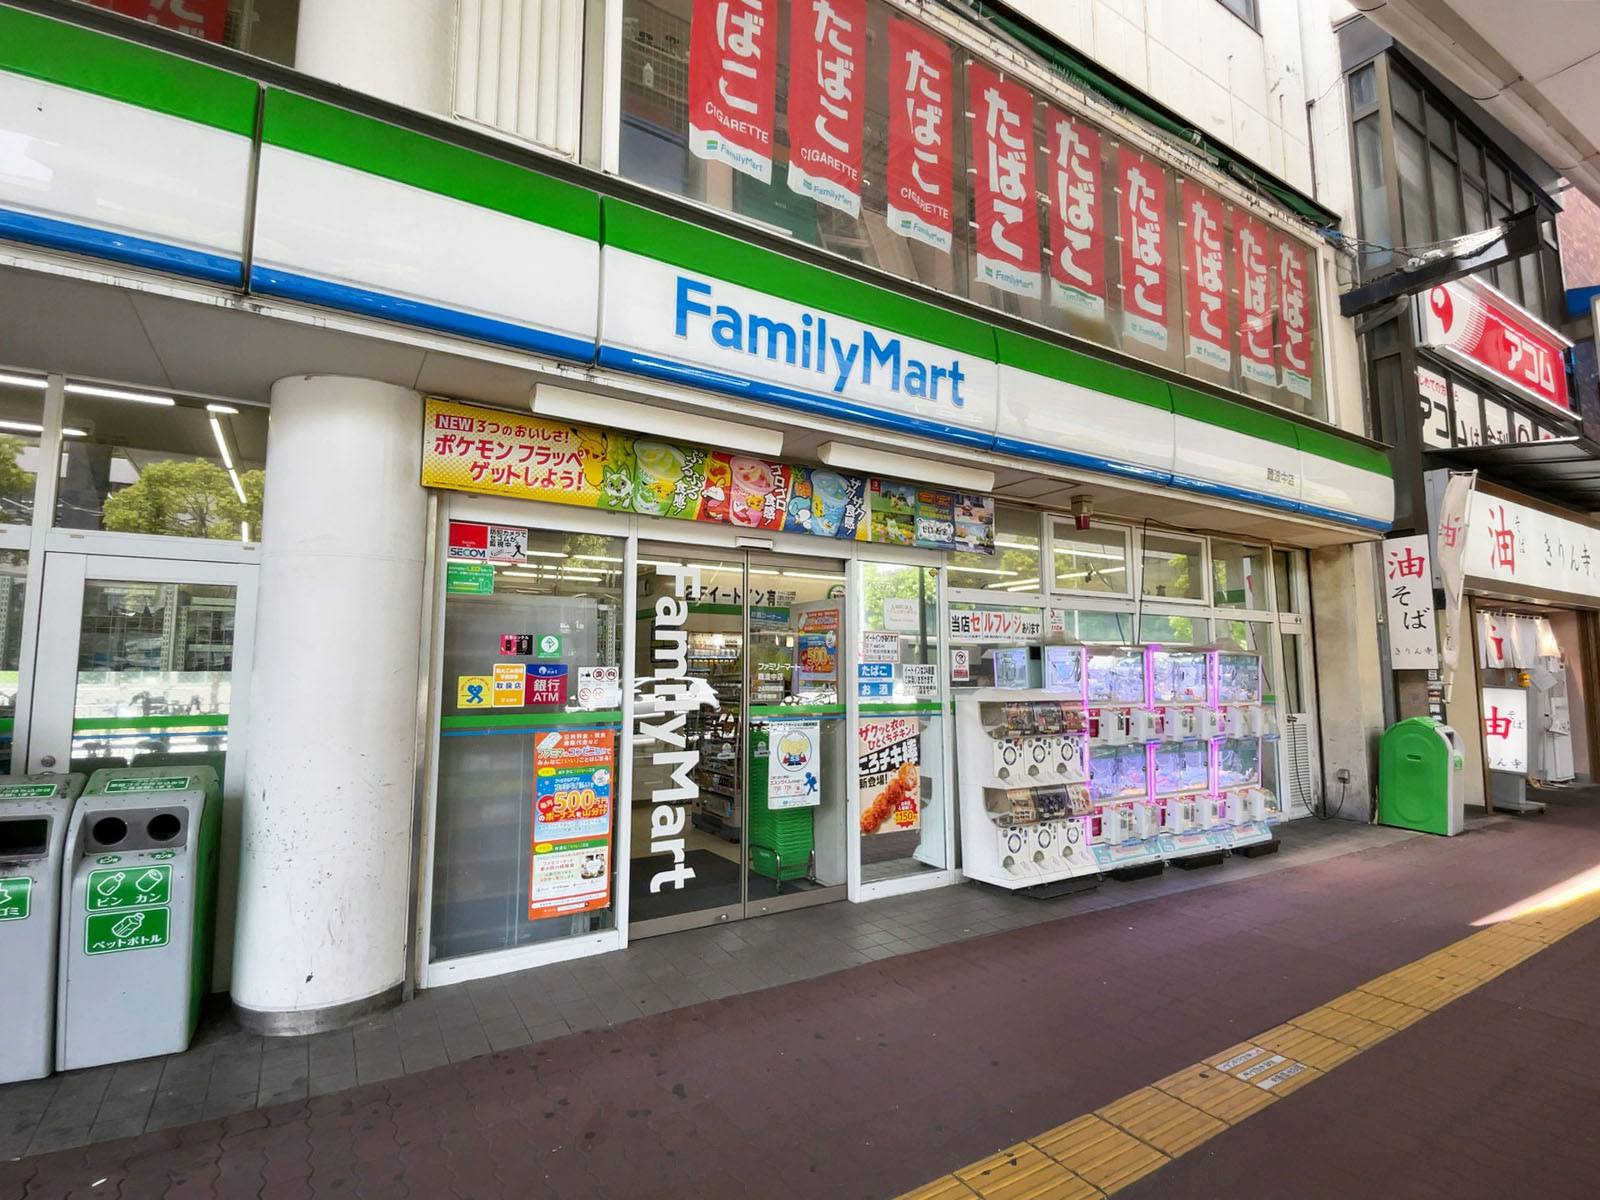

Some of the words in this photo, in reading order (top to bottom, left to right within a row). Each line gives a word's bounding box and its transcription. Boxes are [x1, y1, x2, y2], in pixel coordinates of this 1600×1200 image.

[813, 0, 854, 153] たばこ
[705, 101, 769, 145] CIGARETTE
[905, 49, 943, 195] たばこ
[720, 143, 764, 173] FamilyMart
[800, 147, 858, 181] CIGARETTE
[984, 87, 1027, 261] たばこ
[813, 185, 853, 207] FamilyMart
[900, 186, 950, 220] CIGARETTE
[1055, 120, 1095, 286] たばこ
[912, 222, 946, 244] FamilyMart
[1127, 167, 1163, 316] たばこ
[1191, 200, 1224, 340] たばこ
[1239, 227, 1270, 359] たばこ
[1279, 241, 1307, 370] たばこ
[675, 276, 965, 407] FamilyMart
[1504, 328, 1555, 393] アコム
[438, 415, 473, 432] NEW
[476, 419, 570, 444] 3つのおいしさ!
[469, 461, 584, 491] ゲットしよう!
[682, 450, 703, 500] ぷるぷる
[770, 464, 787, 512] ゴロゴロ
[846, 477, 866, 521] ザクザク
[490, 528, 527, 538] 防犯カメラで
[1488, 504, 1516, 576] 油
[450, 547, 486, 558] SECOM
[1387, 547, 1430, 630] 油そば
[951, 612, 1040, 635] 当店セルフレジあります
[757, 661, 801, 672] ファミリーマート
[807, 646, 828, 667] 500
[861, 665, 888, 676] たばこ
[533, 679, 560, 692] 銀行
[533, 692, 560, 702] ATM
[861, 683, 889, 696] お酒
[640, 563, 700, 894] FamilyMart
[858, 718, 905, 741] ザクッと衣の
[867, 724, 915, 752] ひとくちチキン!
[858, 738, 919, 777] ころチキ棒
[859, 773, 888, 790] 新登場!
[553, 789, 596, 813] 500
[899, 811, 914, 821] 150
[97, 897, 123, 907] ビン
[136, 893, 162, 903] カン
[93, 934, 162, 950] ペットボトル
